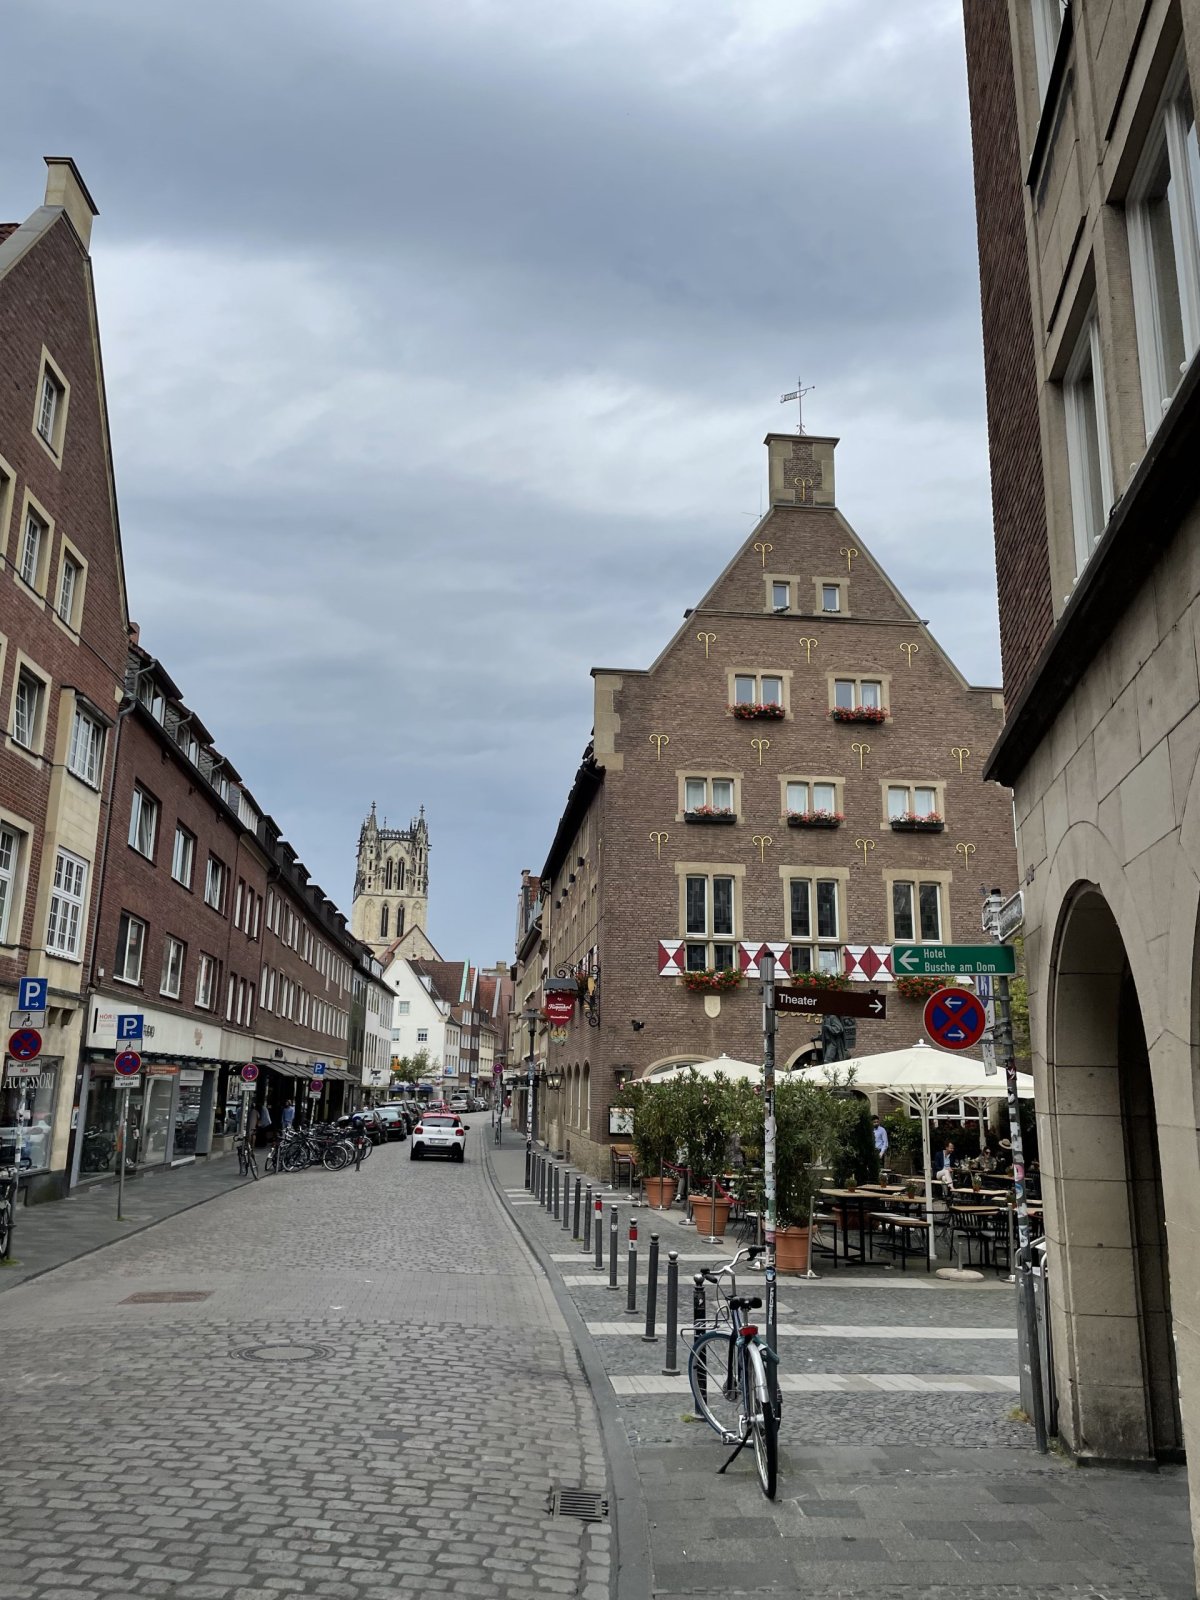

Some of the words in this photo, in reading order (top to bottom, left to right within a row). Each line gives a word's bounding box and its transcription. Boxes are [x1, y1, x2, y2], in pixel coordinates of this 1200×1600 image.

[924, 949, 946, 958] Hotel
[925, 962, 956, 972] Busche
[959, 964, 973, 972] am
[976, 962, 995, 972] Dom
[25, 982, 41, 1006] P
[779, 993, 817, 1006] Theater
[123, 1017, 138, 1036] P
[315, 1063, 322, 1072] P
